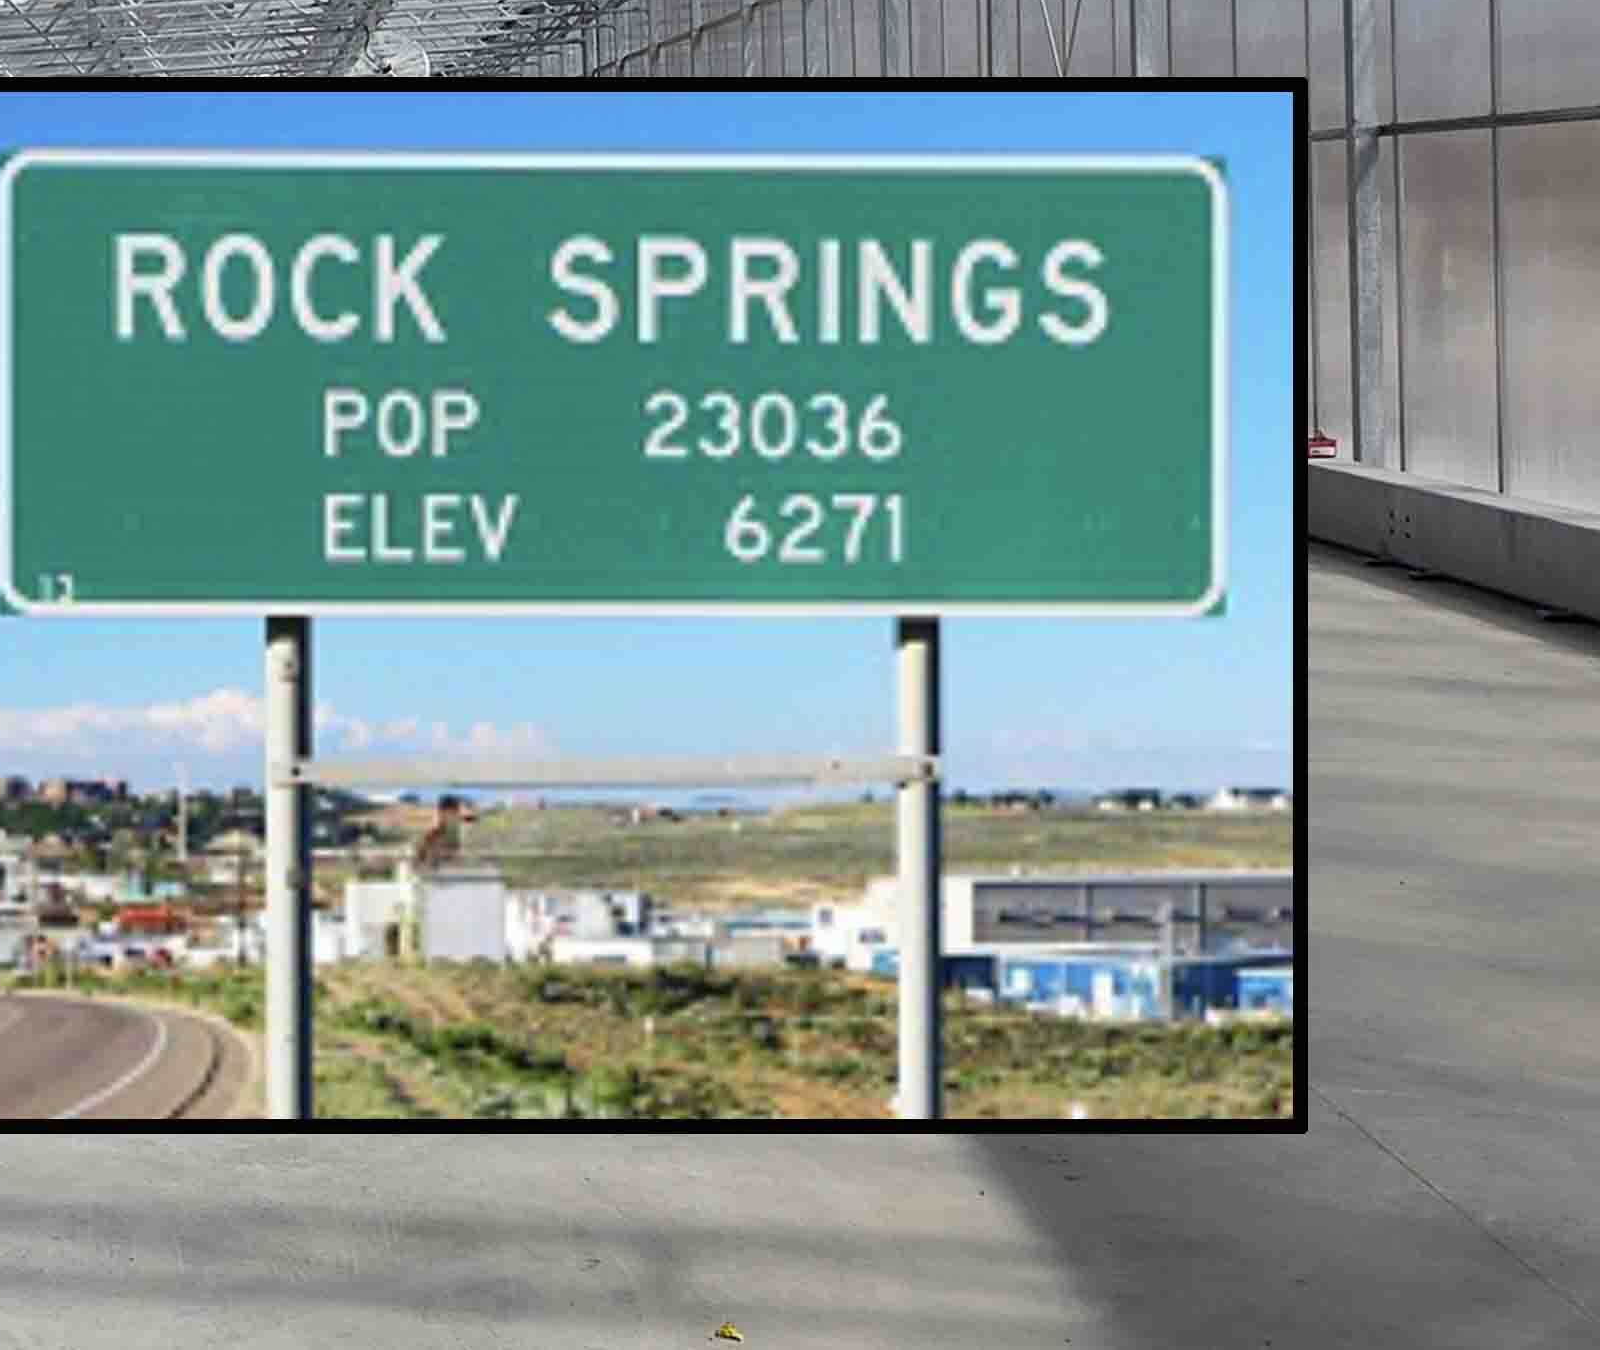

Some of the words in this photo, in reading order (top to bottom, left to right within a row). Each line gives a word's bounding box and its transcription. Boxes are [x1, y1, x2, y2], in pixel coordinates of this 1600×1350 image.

[115, 232, 445, 342] ROCK
[548, 236, 1109, 345] SPRINGS
[323, 388, 480, 457] POP
[643, 390, 901, 459] 23036
[323, 492, 516, 561] ELEV
[724, 494, 903, 563] 6271
